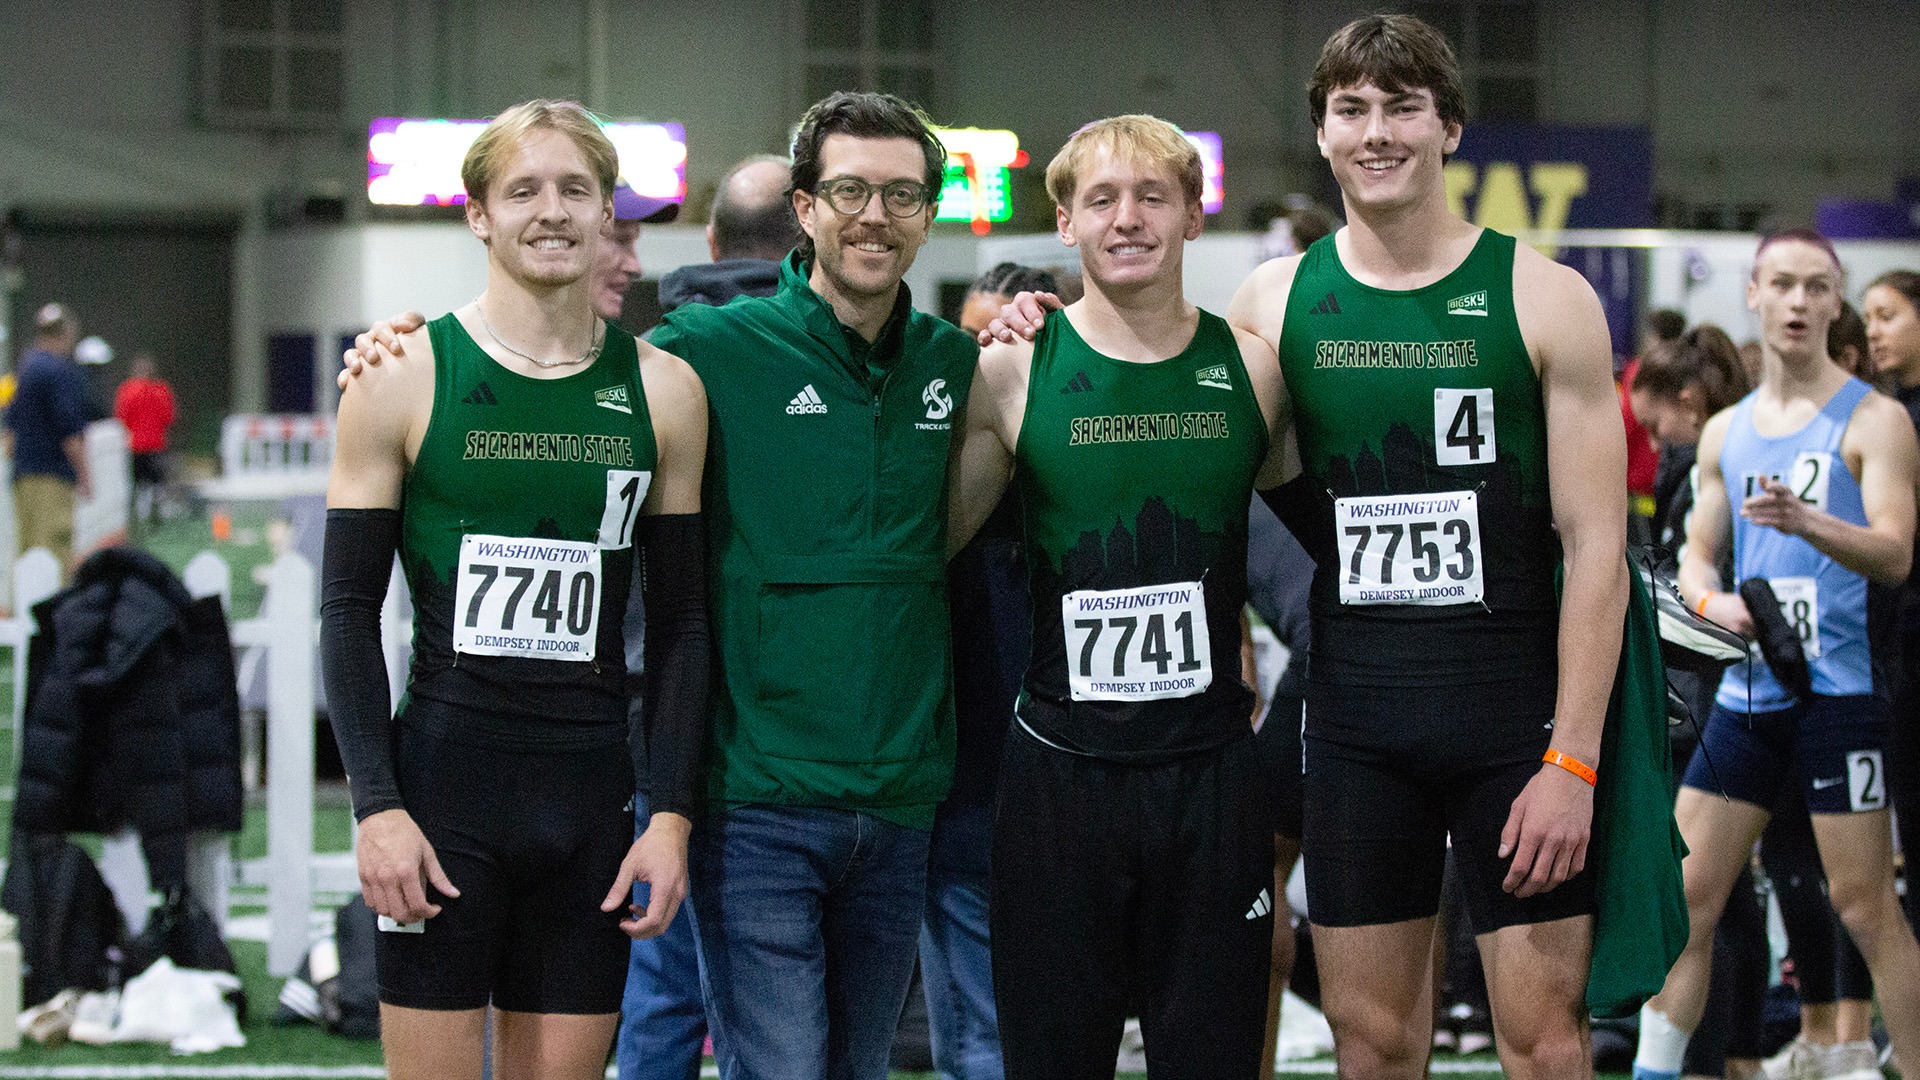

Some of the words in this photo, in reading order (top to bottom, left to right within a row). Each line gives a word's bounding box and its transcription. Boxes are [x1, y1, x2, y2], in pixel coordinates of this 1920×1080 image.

[1314, 340, 1424, 369] SACRAMENTO
[1426, 339, 1479, 368] STATE
[785, 402, 828, 415] adidas
[1069, 412, 1180, 445] SACRAMENTO
[1181, 411, 1230, 439] STATE
[1446, 395, 1486, 460] 4
[463, 430, 582, 461] SACRAMENTO
[583, 434, 634, 467] STATE
[1799, 457, 1820, 504] 2
[618, 476, 640, 546] 1
[1350, 498, 1462, 519] WASHINGTON
[477, 541, 591, 564] WASHINGTON
[1344, 518, 1475, 585] 7753
[464, 563, 596, 636] 7740
[1079, 589, 1192, 612] WASHINGTON
[1360, 588, 1415, 601] DEMPSEY
[1418, 585, 1466, 599] INDOOR
[474, 635, 534, 651] DEMPSEY
[536, 638, 581, 653] INDOOR
[1074, 610, 1202, 678] 7741
[1090, 681, 1146, 694] DEMPSEY
[1149, 677, 1196, 691] INDOOR
[1857, 756, 1880, 803] 2
